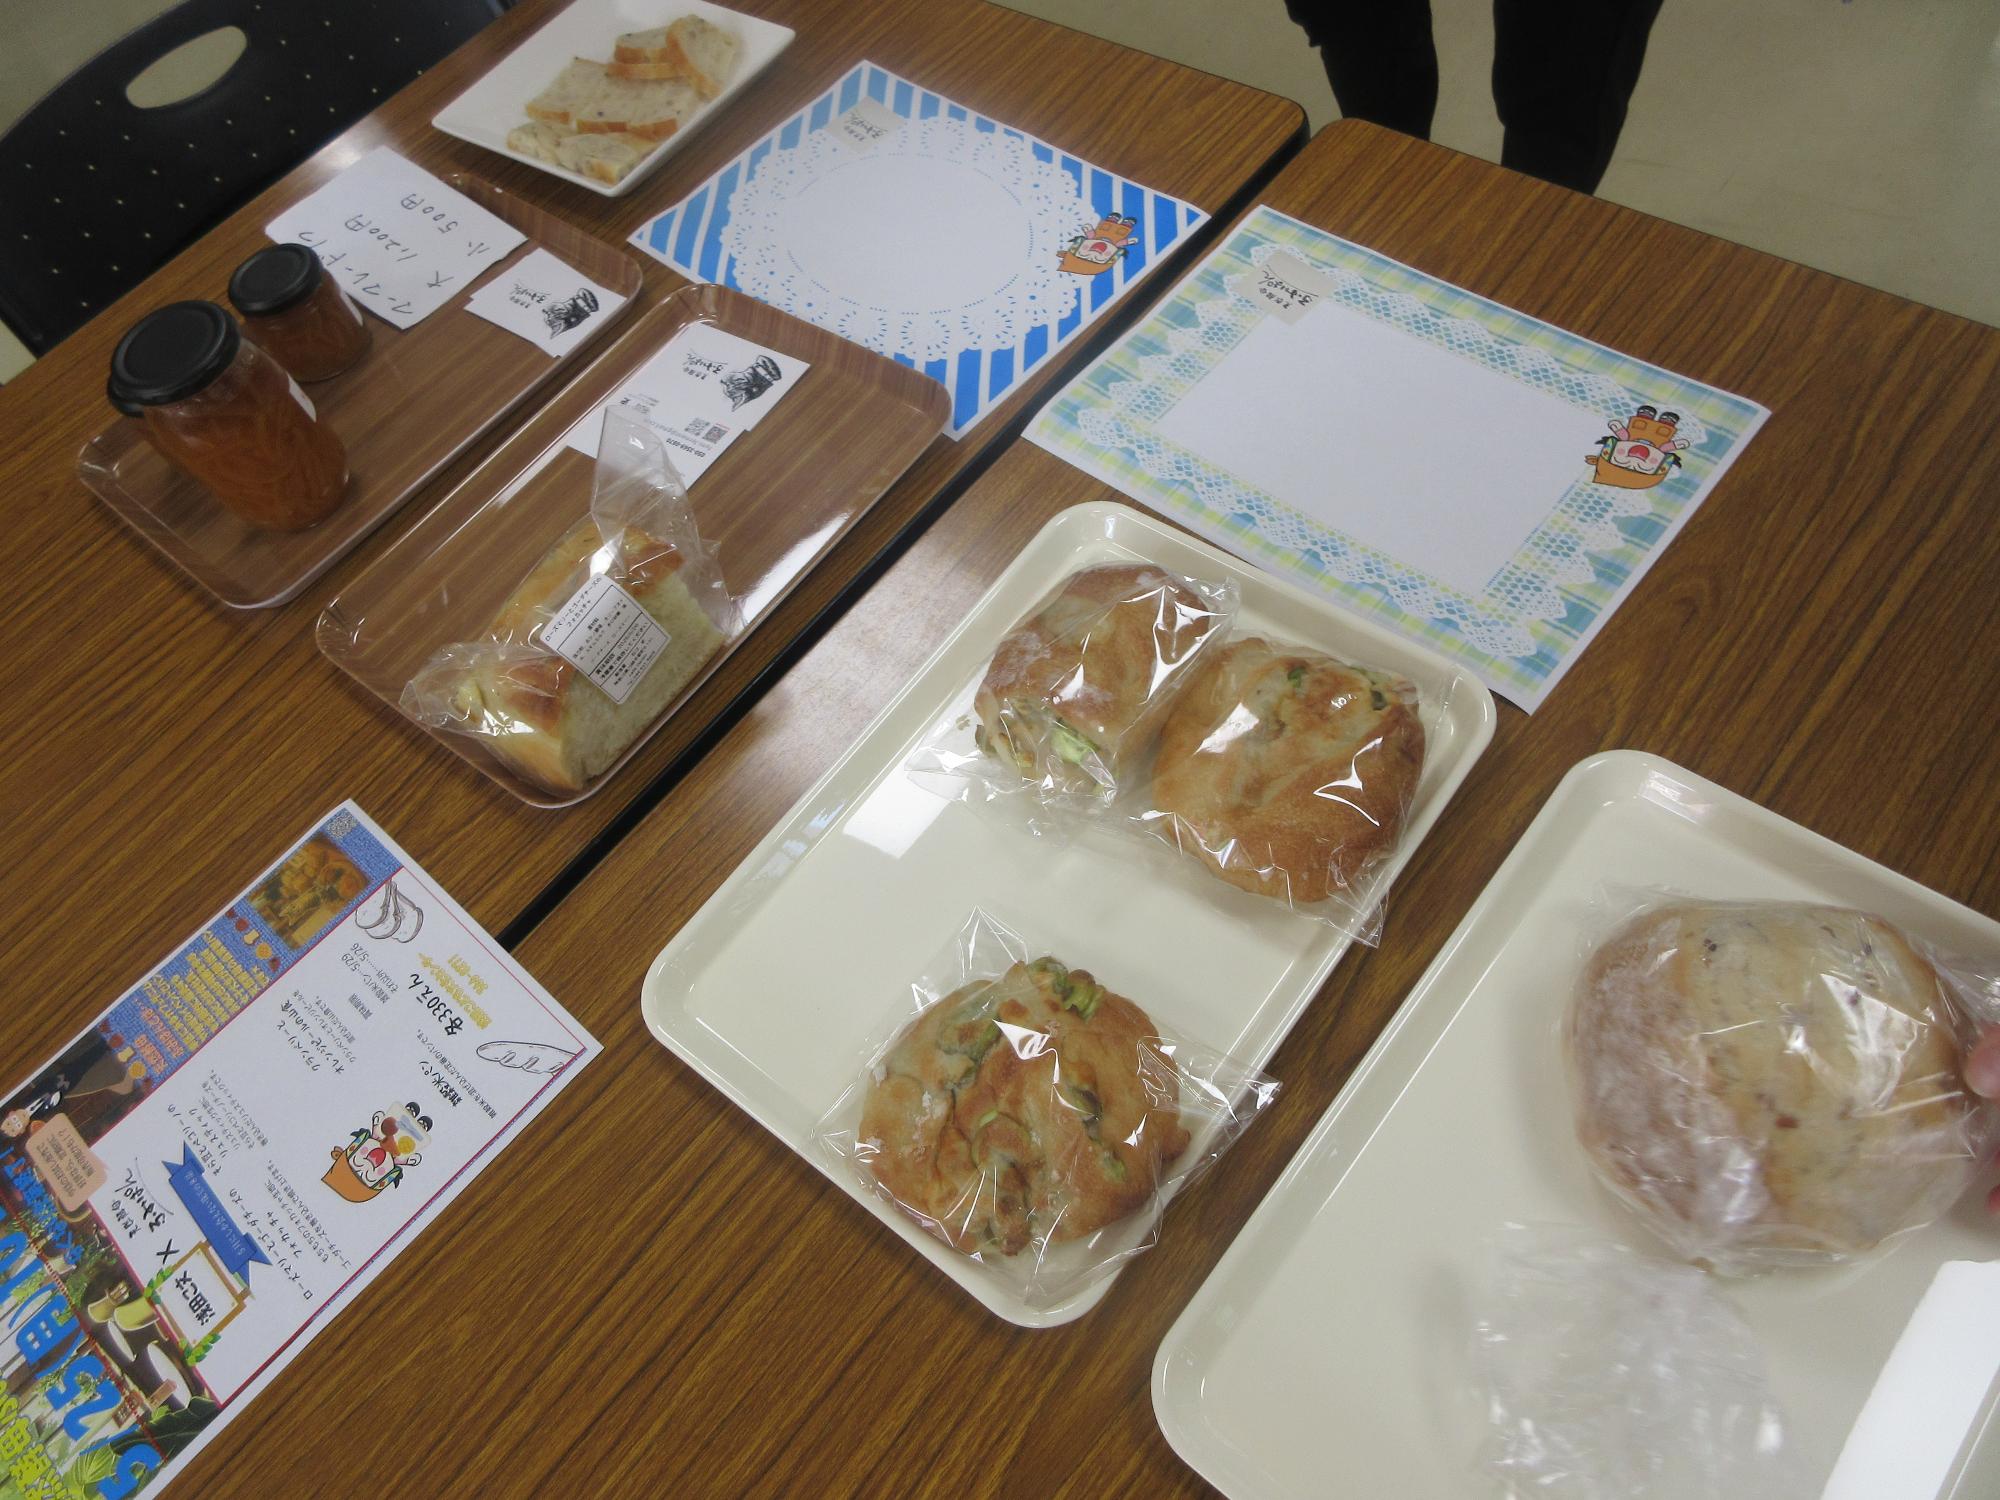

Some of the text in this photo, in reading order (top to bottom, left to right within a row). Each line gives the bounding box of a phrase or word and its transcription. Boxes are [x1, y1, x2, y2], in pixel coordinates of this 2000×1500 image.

[399, 192, 491, 257] 小 500円
[427, 270, 455, 289] 大
[402, 971, 466, 1039] 各330えん
[275, 1019, 321, 1072] クランベリーと
[278, 998, 345, 1075] オレンジピールの山食
[416, 1057, 463, 1107] 雑穀米パン
[187, 1105, 229, 1158] リュスティック
[227, 1186, 313, 1302] ローズマリーとゴーダチーズの
[263, 1209, 303, 1259] フォカッチャ
